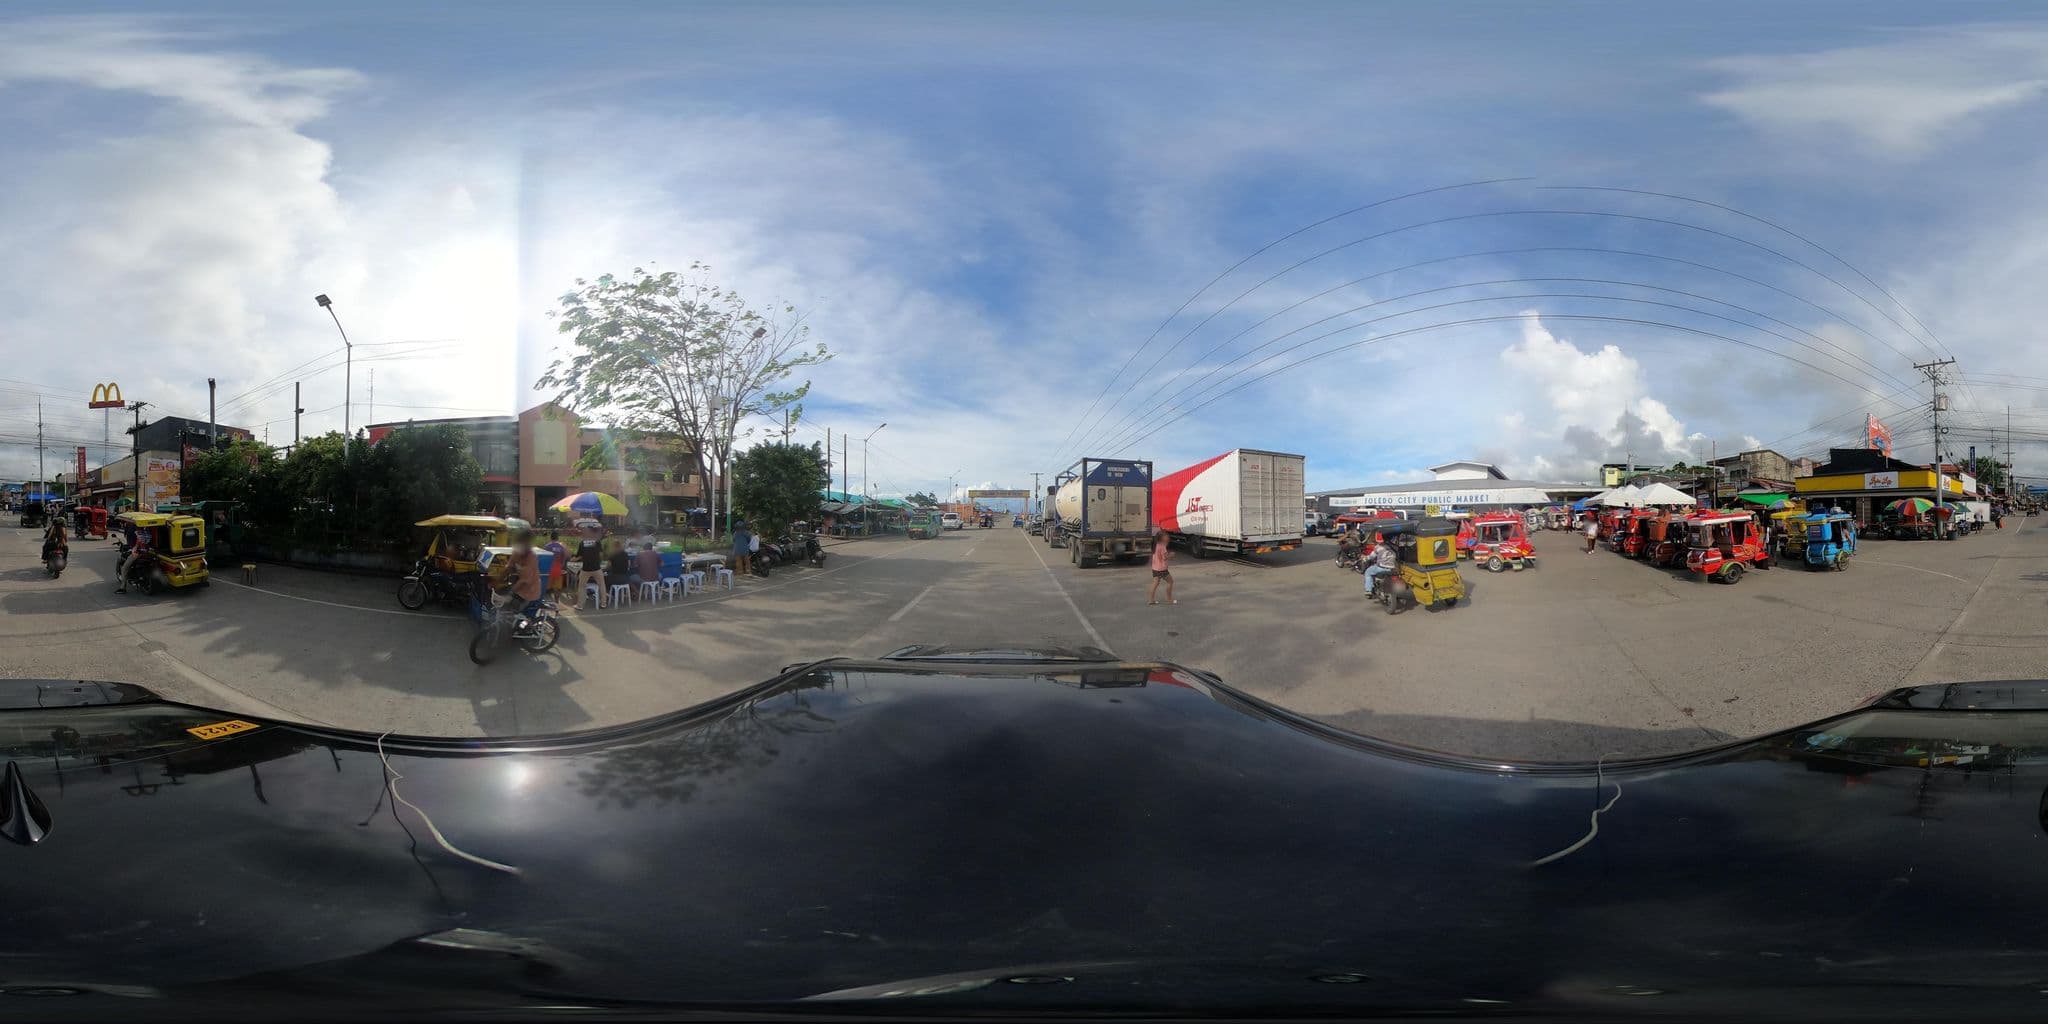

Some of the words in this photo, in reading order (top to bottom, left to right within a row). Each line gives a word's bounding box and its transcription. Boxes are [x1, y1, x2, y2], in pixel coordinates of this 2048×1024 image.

[1185, 497, 1203, 512] J&T
[1398, 496, 1417, 504] CITY
[1456, 494, 1489, 503] MARKET
